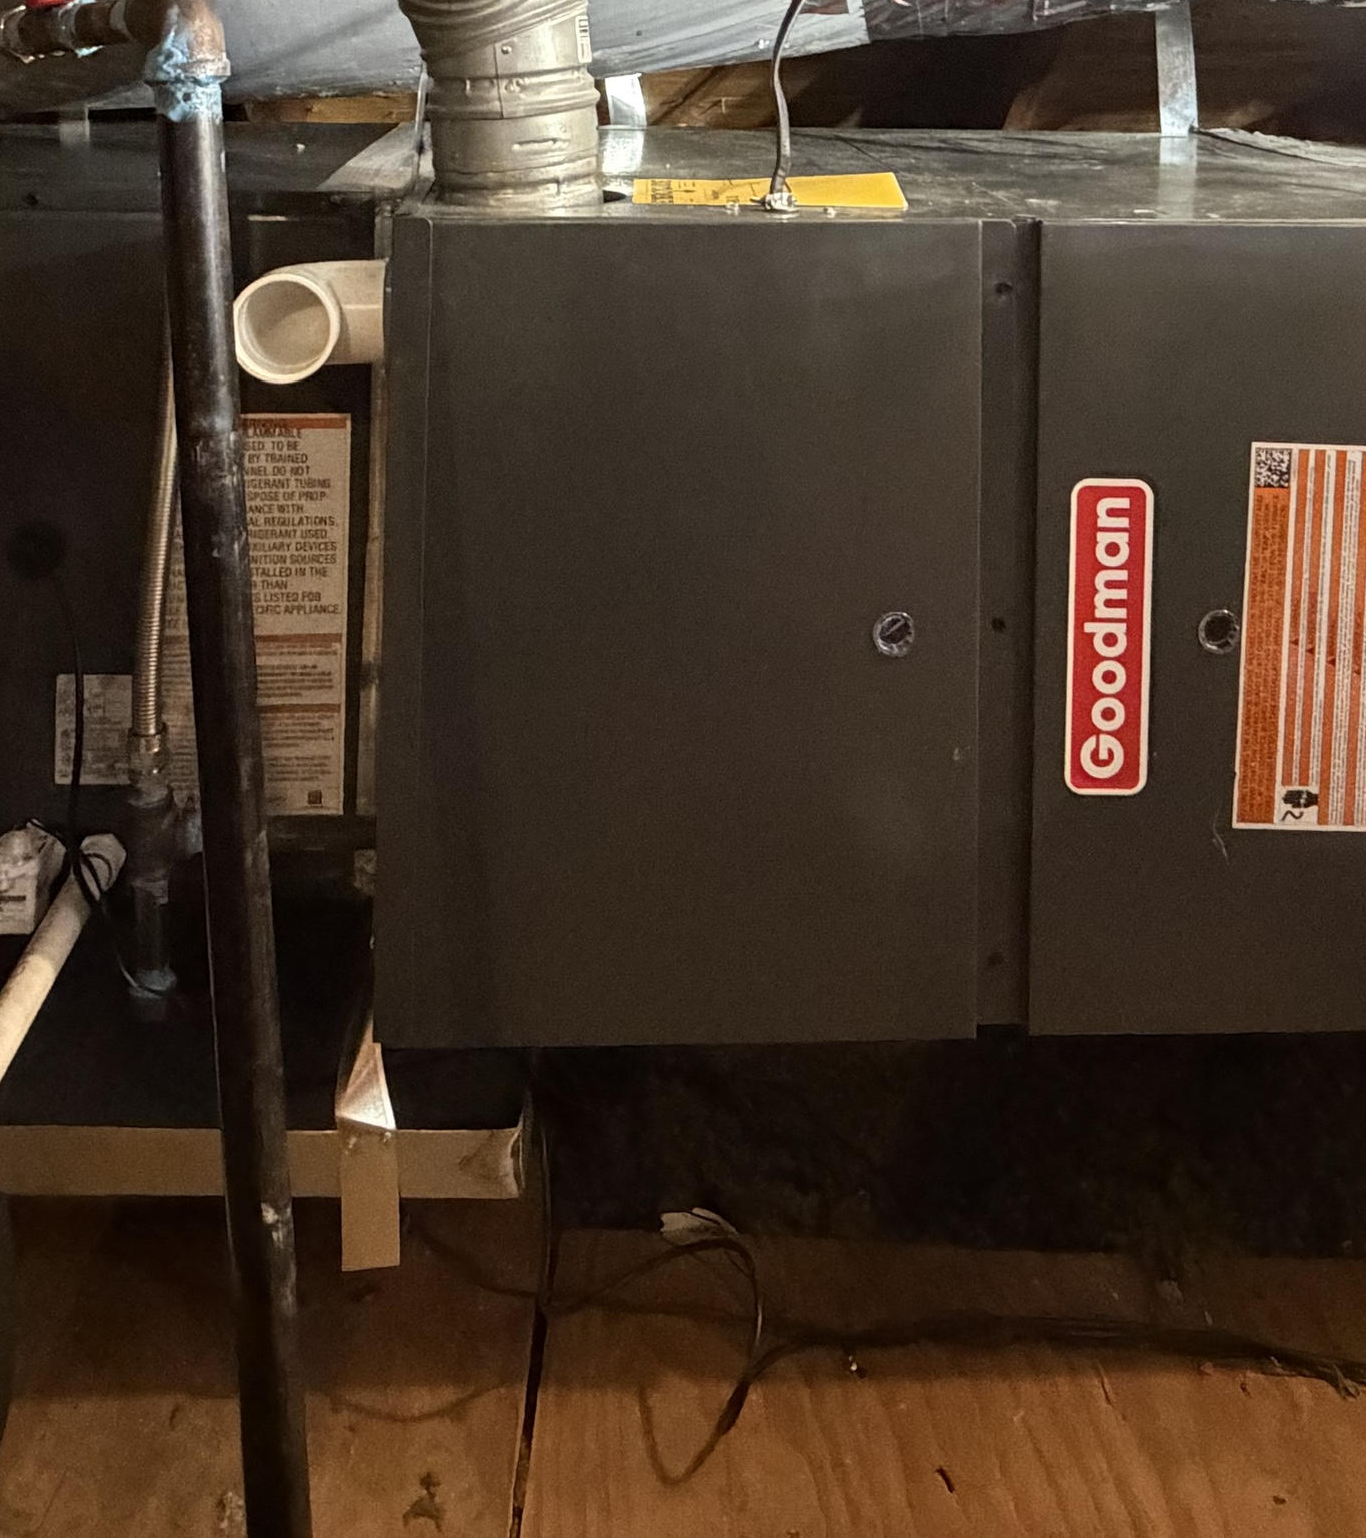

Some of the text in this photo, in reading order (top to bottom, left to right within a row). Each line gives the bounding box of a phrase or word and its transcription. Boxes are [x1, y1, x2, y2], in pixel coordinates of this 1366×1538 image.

[248, 453, 308, 464] BY TRAINED
[293, 478, 331, 489] TUBING
[276, 503, 303, 514] WITH
[295, 541, 337, 552] DEVICES
[289, 554, 337, 564] SOURCES
[261, 579, 288, 590] THAN
[264, 591, 299, 603] LISTED
[1079, 497, 1131, 780] Goodman
